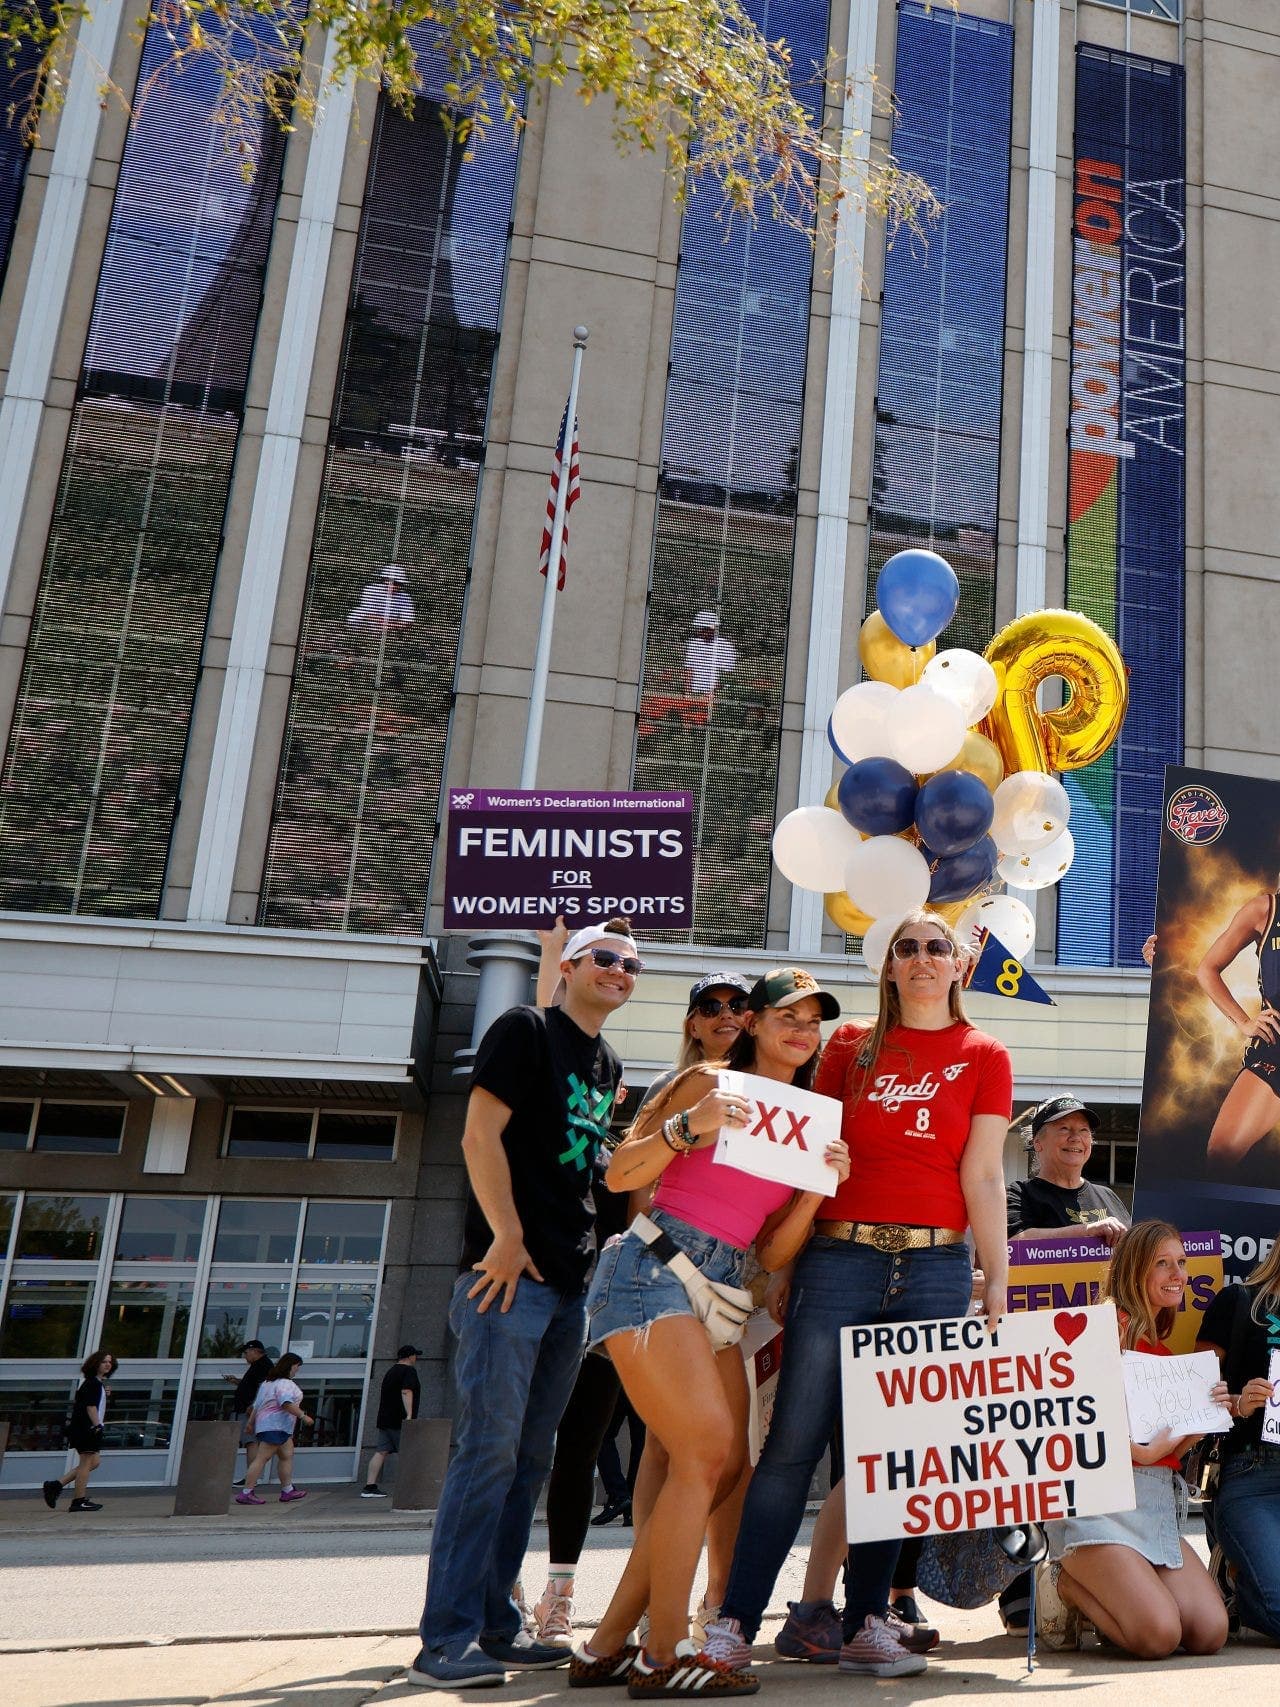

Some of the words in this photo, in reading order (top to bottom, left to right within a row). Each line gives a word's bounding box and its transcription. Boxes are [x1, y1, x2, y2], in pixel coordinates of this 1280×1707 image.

[1125, 179, 1185, 456] AMERICA
[488, 795, 541, 807] Women's
[544, 797, 610, 808] Declaration
[612, 797, 685, 809] International
[1170, 800, 1227, 829] Fever
[1177, 791, 1216, 807] INDIANA
[459, 827, 683, 859] FEMINISTS
[552, 870, 591, 885] FOR
[453, 896, 581, 915] WOMEN'S
[587, 896, 685, 915] SPORTS
[996, 958, 1023, 996] 8
[868, 1072, 941, 1102] Indy
[750, 1100, 812, 1151] XX
[916, 1107, 930, 1131] 8
[1026, 1244, 1077, 1260] Women's
[851, 1318, 1003, 1358] PROTECT
[875, 1347, 1075, 1407] WOMEN'S
[1126, 1359, 1204, 1390] THANK
[963, 1395, 1097, 1435] SPORTS
[1152, 1387, 1192, 1417] YOU
[857, 1438, 1009, 1494] THANK
[1016, 1431, 1107, 1476] YOU
[902, 1479, 1077, 1534] SOPHIE!
